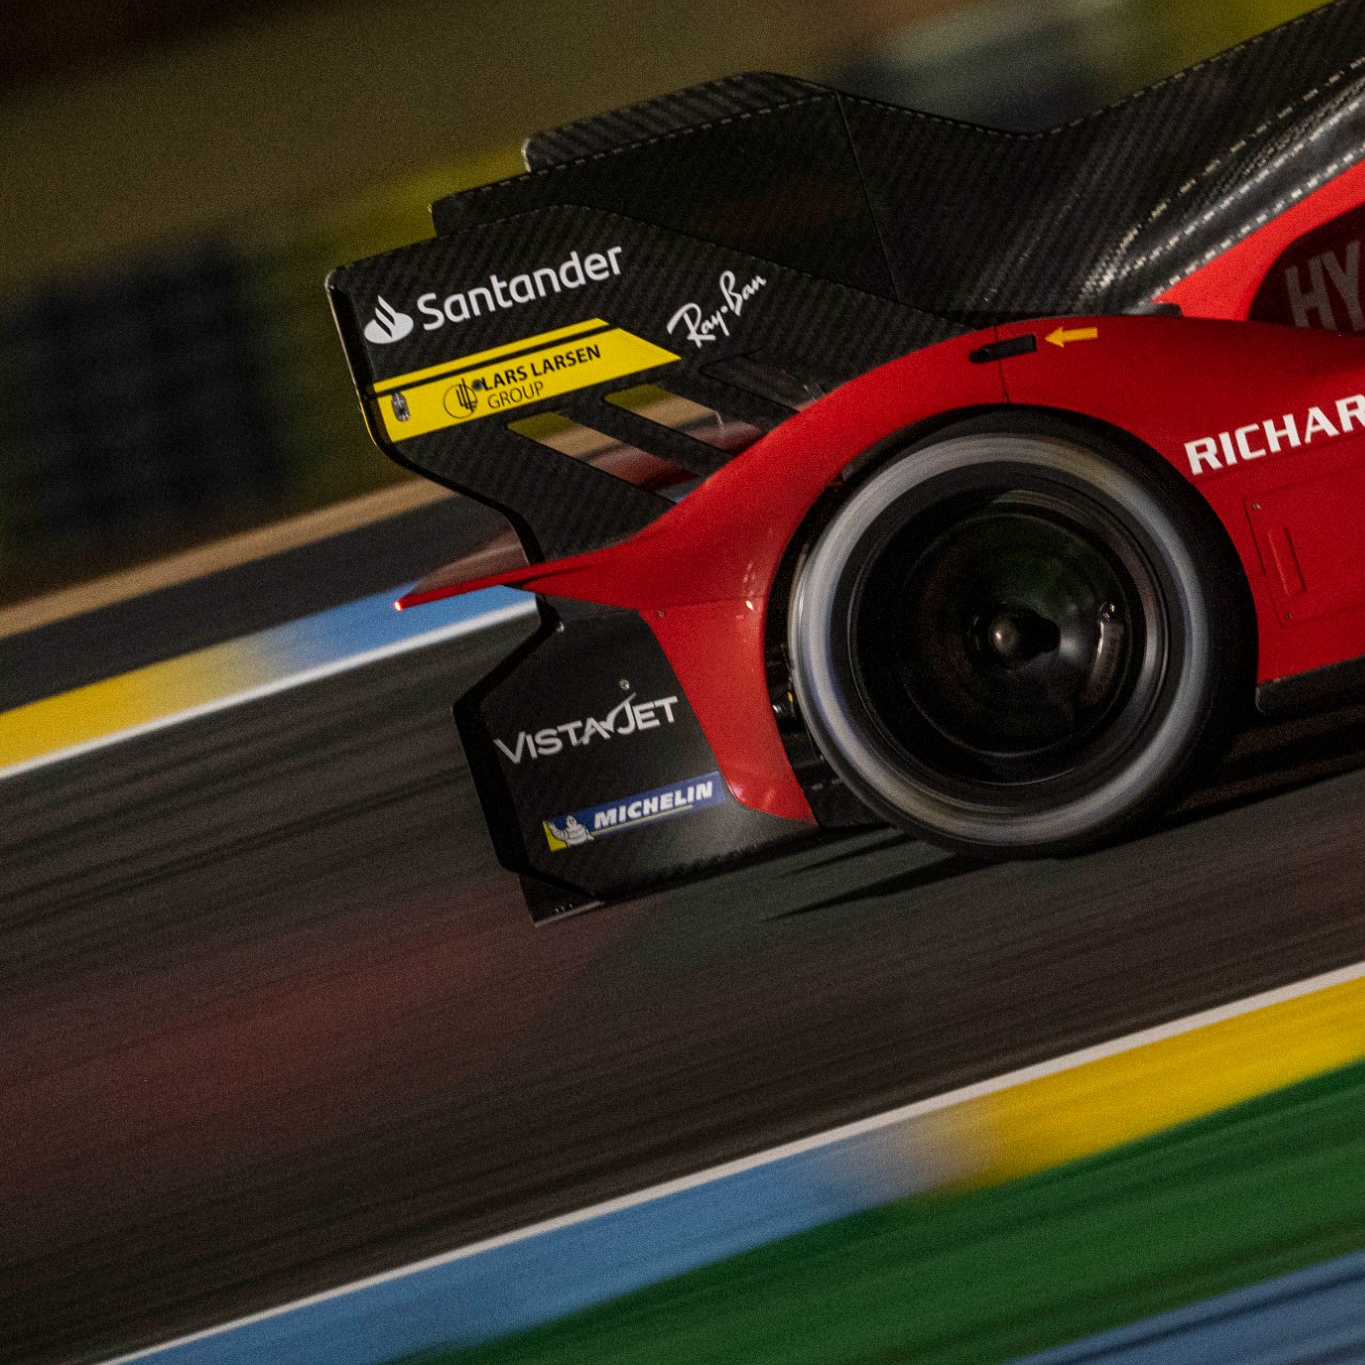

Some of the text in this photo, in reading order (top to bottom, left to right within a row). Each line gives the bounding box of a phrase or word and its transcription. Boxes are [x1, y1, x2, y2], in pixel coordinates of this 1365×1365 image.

[416, 246, 622, 331] Santander
[479, 343, 601, 392] LARS LARSEN
[486, 381, 544, 411] GROUP
[493, 692, 679, 764] VISTAJET
[593, 781, 714, 829] MICHELIN
